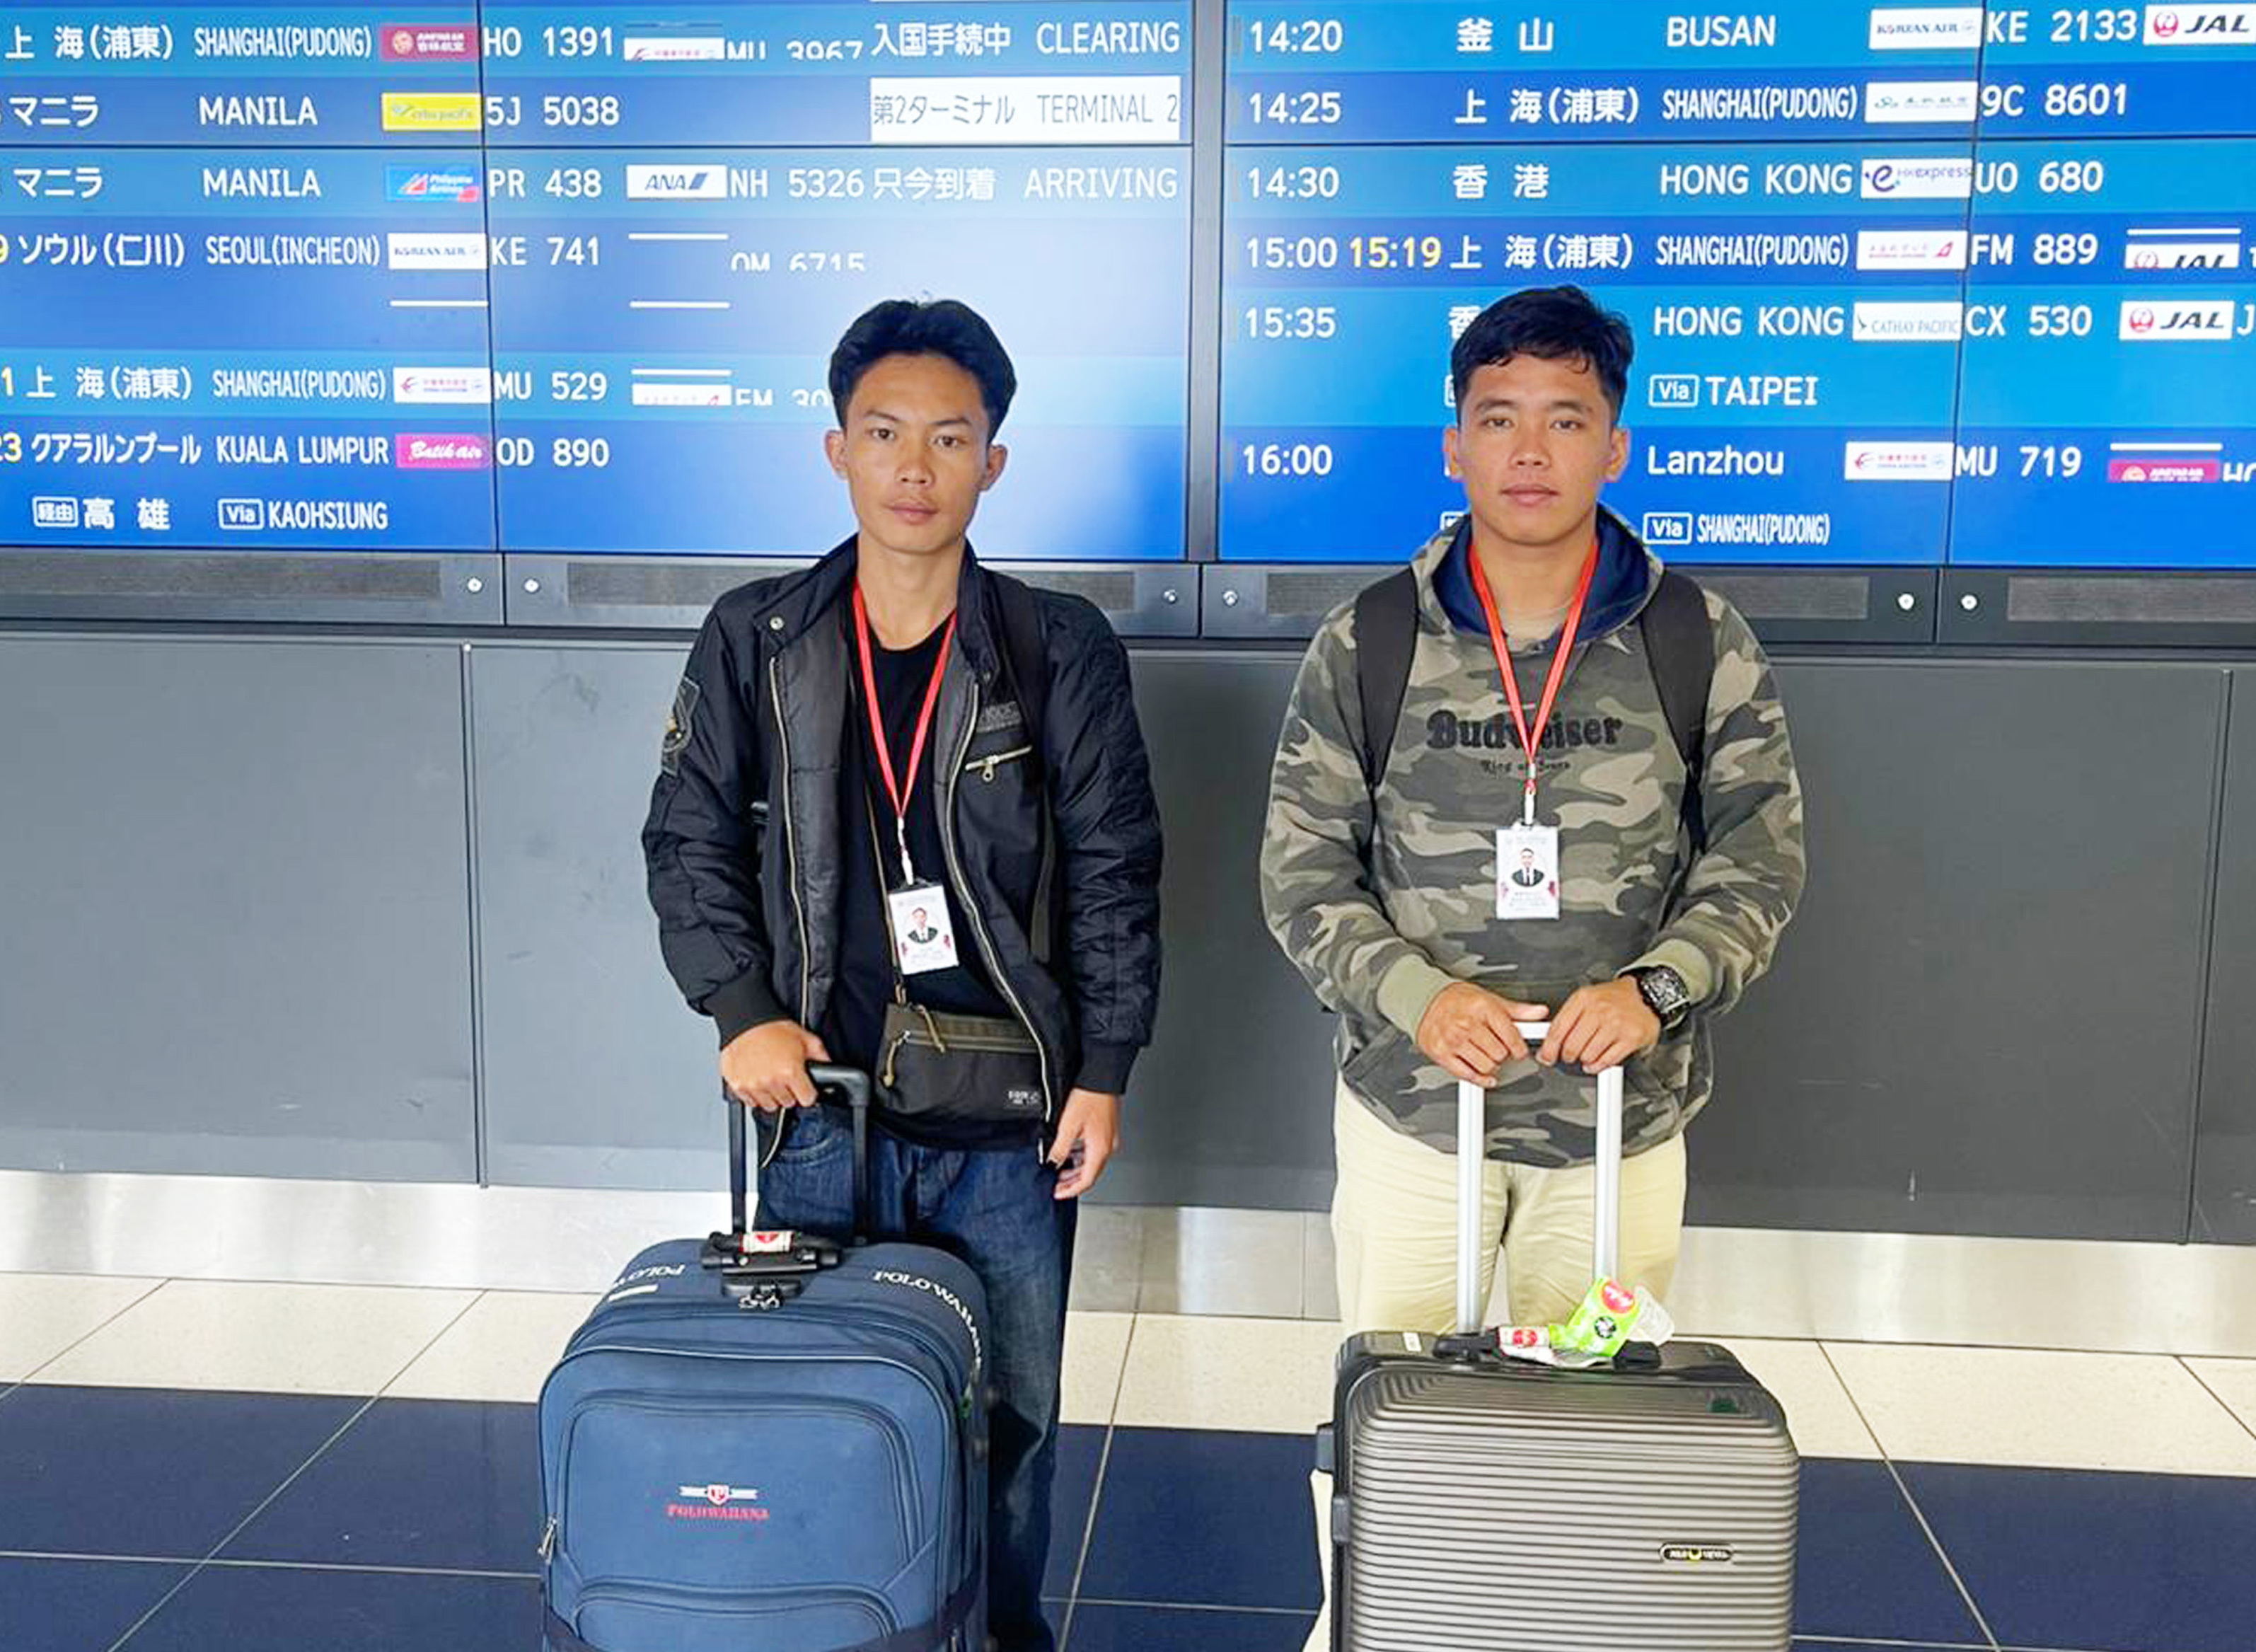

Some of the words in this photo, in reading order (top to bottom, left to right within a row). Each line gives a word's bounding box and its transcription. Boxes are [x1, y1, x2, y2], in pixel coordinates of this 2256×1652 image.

[871, 22, 1011, 57] 入国手続中
[1036, 21, 1180, 54] CLEARING
[1251, 20, 1343, 52] 14:20
[1456, 18, 1554, 52] 釜山
[1667, 15, 1776, 47] BUSAN
[1985, 11, 2029, 43] KE
[2050, 9, 2137, 42] 2133
[2185, 14, 2250, 34] JAL
[194, 25, 371, 58] SHANGHAI(PUDONG)
[482, 27, 521, 57] HO
[543, 26, 613, 57] 1391
[9, 96, 98, 127] マニラ
[199, 96, 318, 126] MANILA
[485, 96, 521, 126] 5J
[544, 96, 620, 126] 5038
[874, 95, 1015, 125] 第2ターミナル
[1036, 94, 1153, 123] TERMINAL
[1167, 93, 1178, 122] 2
[1249, 92, 1341, 124] 14:25
[1662, 85, 1858, 120] SHANGHAI(PUDONG)
[1980, 85, 2025, 117] 9C
[2044, 83, 2127, 116] 8601
[13, 167, 103, 198] マニラ
[203, 168, 321, 197] MANILA
[487, 168, 525, 197] PR
[544, 168, 602, 198] 438
[644, 174, 688, 191] ANA
[731, 169, 768, 197] NH
[789, 168, 865, 198] 5326
[873, 167, 996, 201] 只今到着
[1024, 167, 1177, 199] ARRIVING
[1248, 166, 1339, 198] 14:30
[1452, 163, 1549, 199] 香港
[1660, 164, 1749, 195] HONG
[1765, 163, 1853, 195] KONG
[1974, 162, 2018, 193] UO
[2039, 161, 2103, 192] 680
[18, 232, 185, 267] ソウル(仁川)
[206, 233, 381, 267] SEOUL(INCHEON)
[490, 236, 527, 265] KE
[547, 236, 598, 265] 741
[1246, 237, 1338, 268] 15:00
[1349, 236, 1442, 268] 15:19
[1655, 233, 1849, 267] SHANGHAI(PUDONG)
[1970, 233, 2014, 265] FM
[2033, 233, 2098, 265] 889
[1245, 306, 1335, 338] 15:35
[1654, 306, 1742, 336] HONG
[1758, 306, 1844, 336] KONG
[1965, 306, 2006, 336] CX
[2029, 305, 2093, 336] 530
[2160, 312, 2224, 329] JAL
[212, 369, 386, 400] SHANGHAI(PUDONG)
[493, 371, 531, 400] MU
[552, 371, 607, 400] 529
[1659, 382, 1690, 401] Via
[1704, 376, 1818, 406] TAIPEI
[0, 432, 22, 462] 3
[31, 431, 202, 464] クアラルンプール
[216, 435, 289, 463] KUALA
[298, 436, 389, 464] LUMPUR
[496, 437, 534, 466] OD
[553, 438, 609, 467] 890
[1243, 444, 1332, 475] 16:00
[1648, 444, 1784, 475] Lanzhou
[1955, 445, 1998, 476] MU
[2020, 446, 2081, 478] 719
[82, 497, 170, 530] 高雄
[226, 507, 257, 524] Via
[268, 501, 388, 530] KAOHSIUNG
[1652, 520, 1684, 538] Via
[1696, 513, 1830, 545] SHANGHAI(PUDONG)
